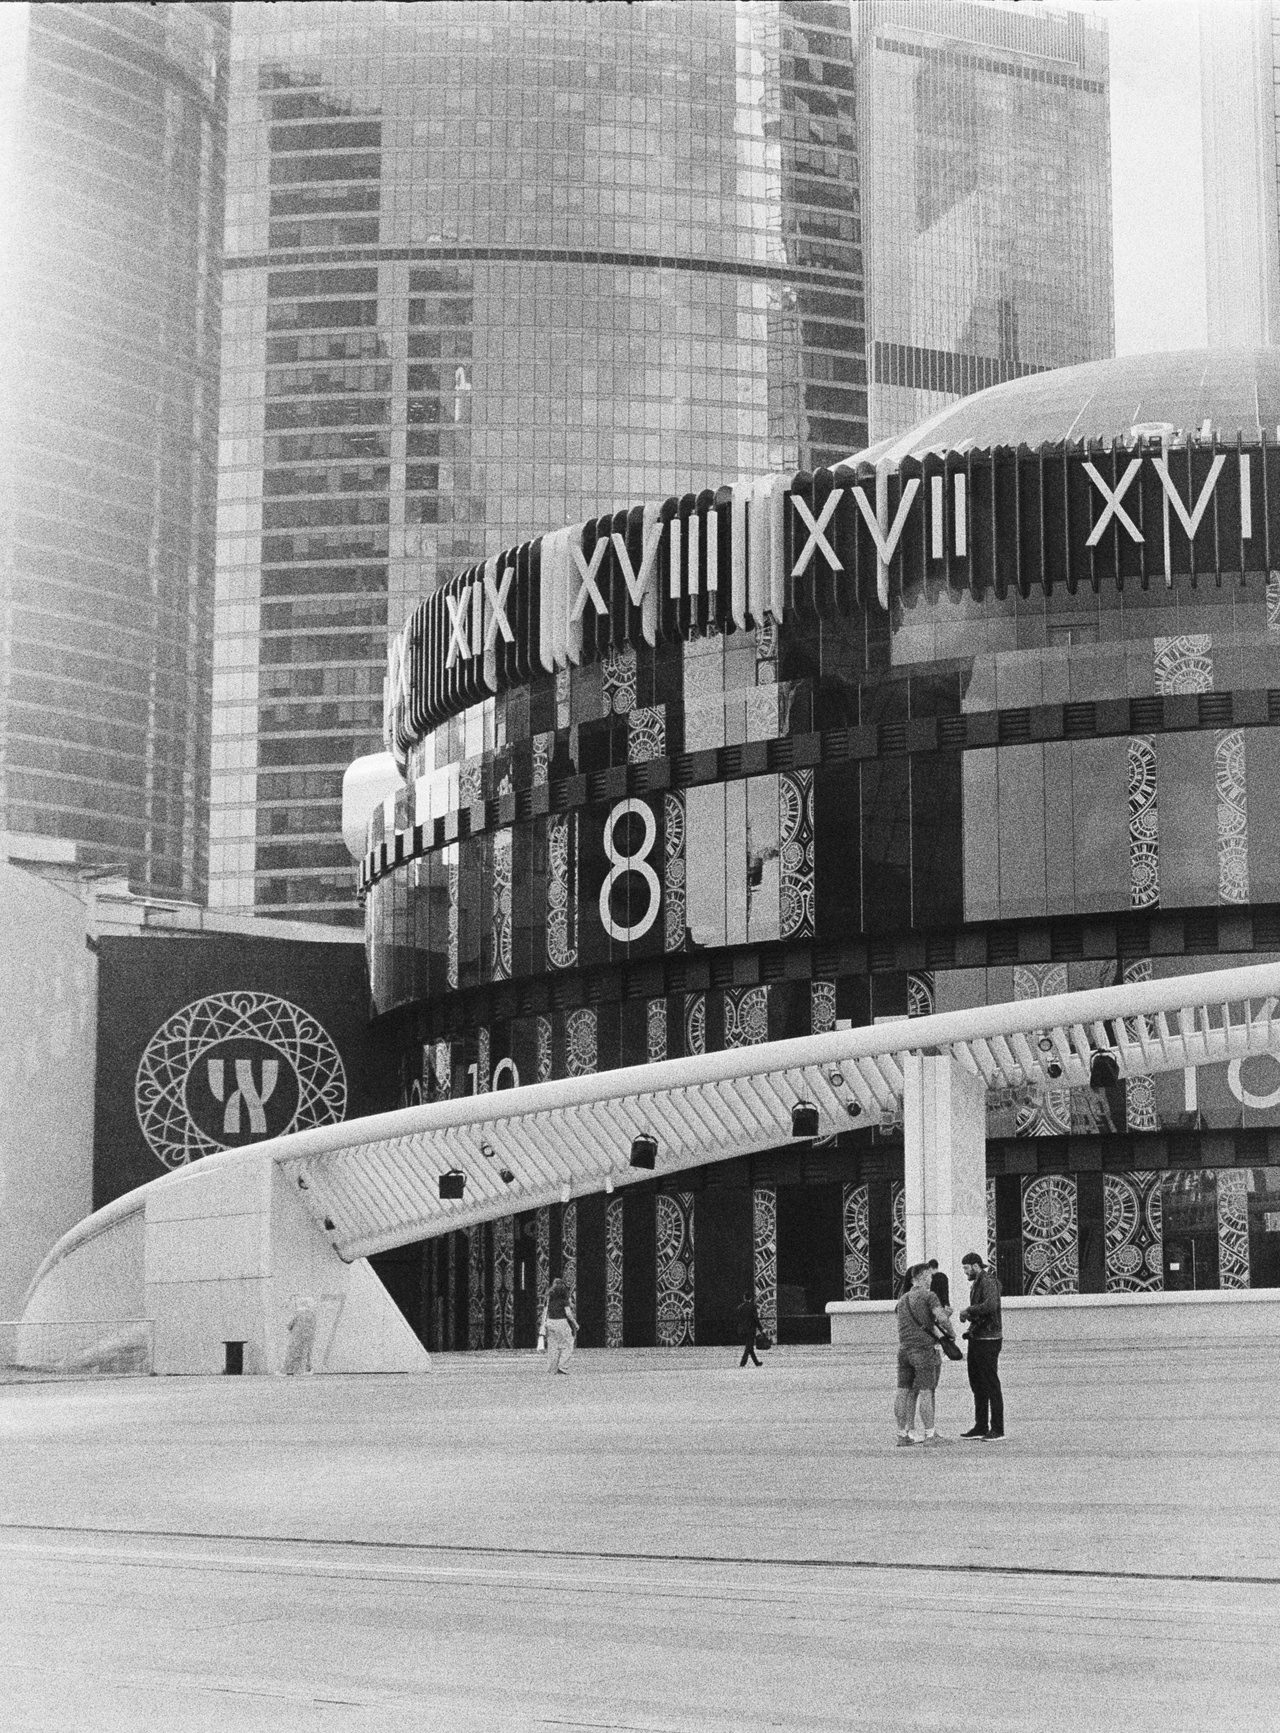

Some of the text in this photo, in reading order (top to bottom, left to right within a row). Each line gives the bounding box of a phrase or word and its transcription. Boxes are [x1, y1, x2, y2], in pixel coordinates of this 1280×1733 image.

[790, 473, 967, 577] XVII
[1082, 453, 1252, 546] XVI
[445, 566, 514, 668] XIX
[570, 511, 720, 622] XVIII
